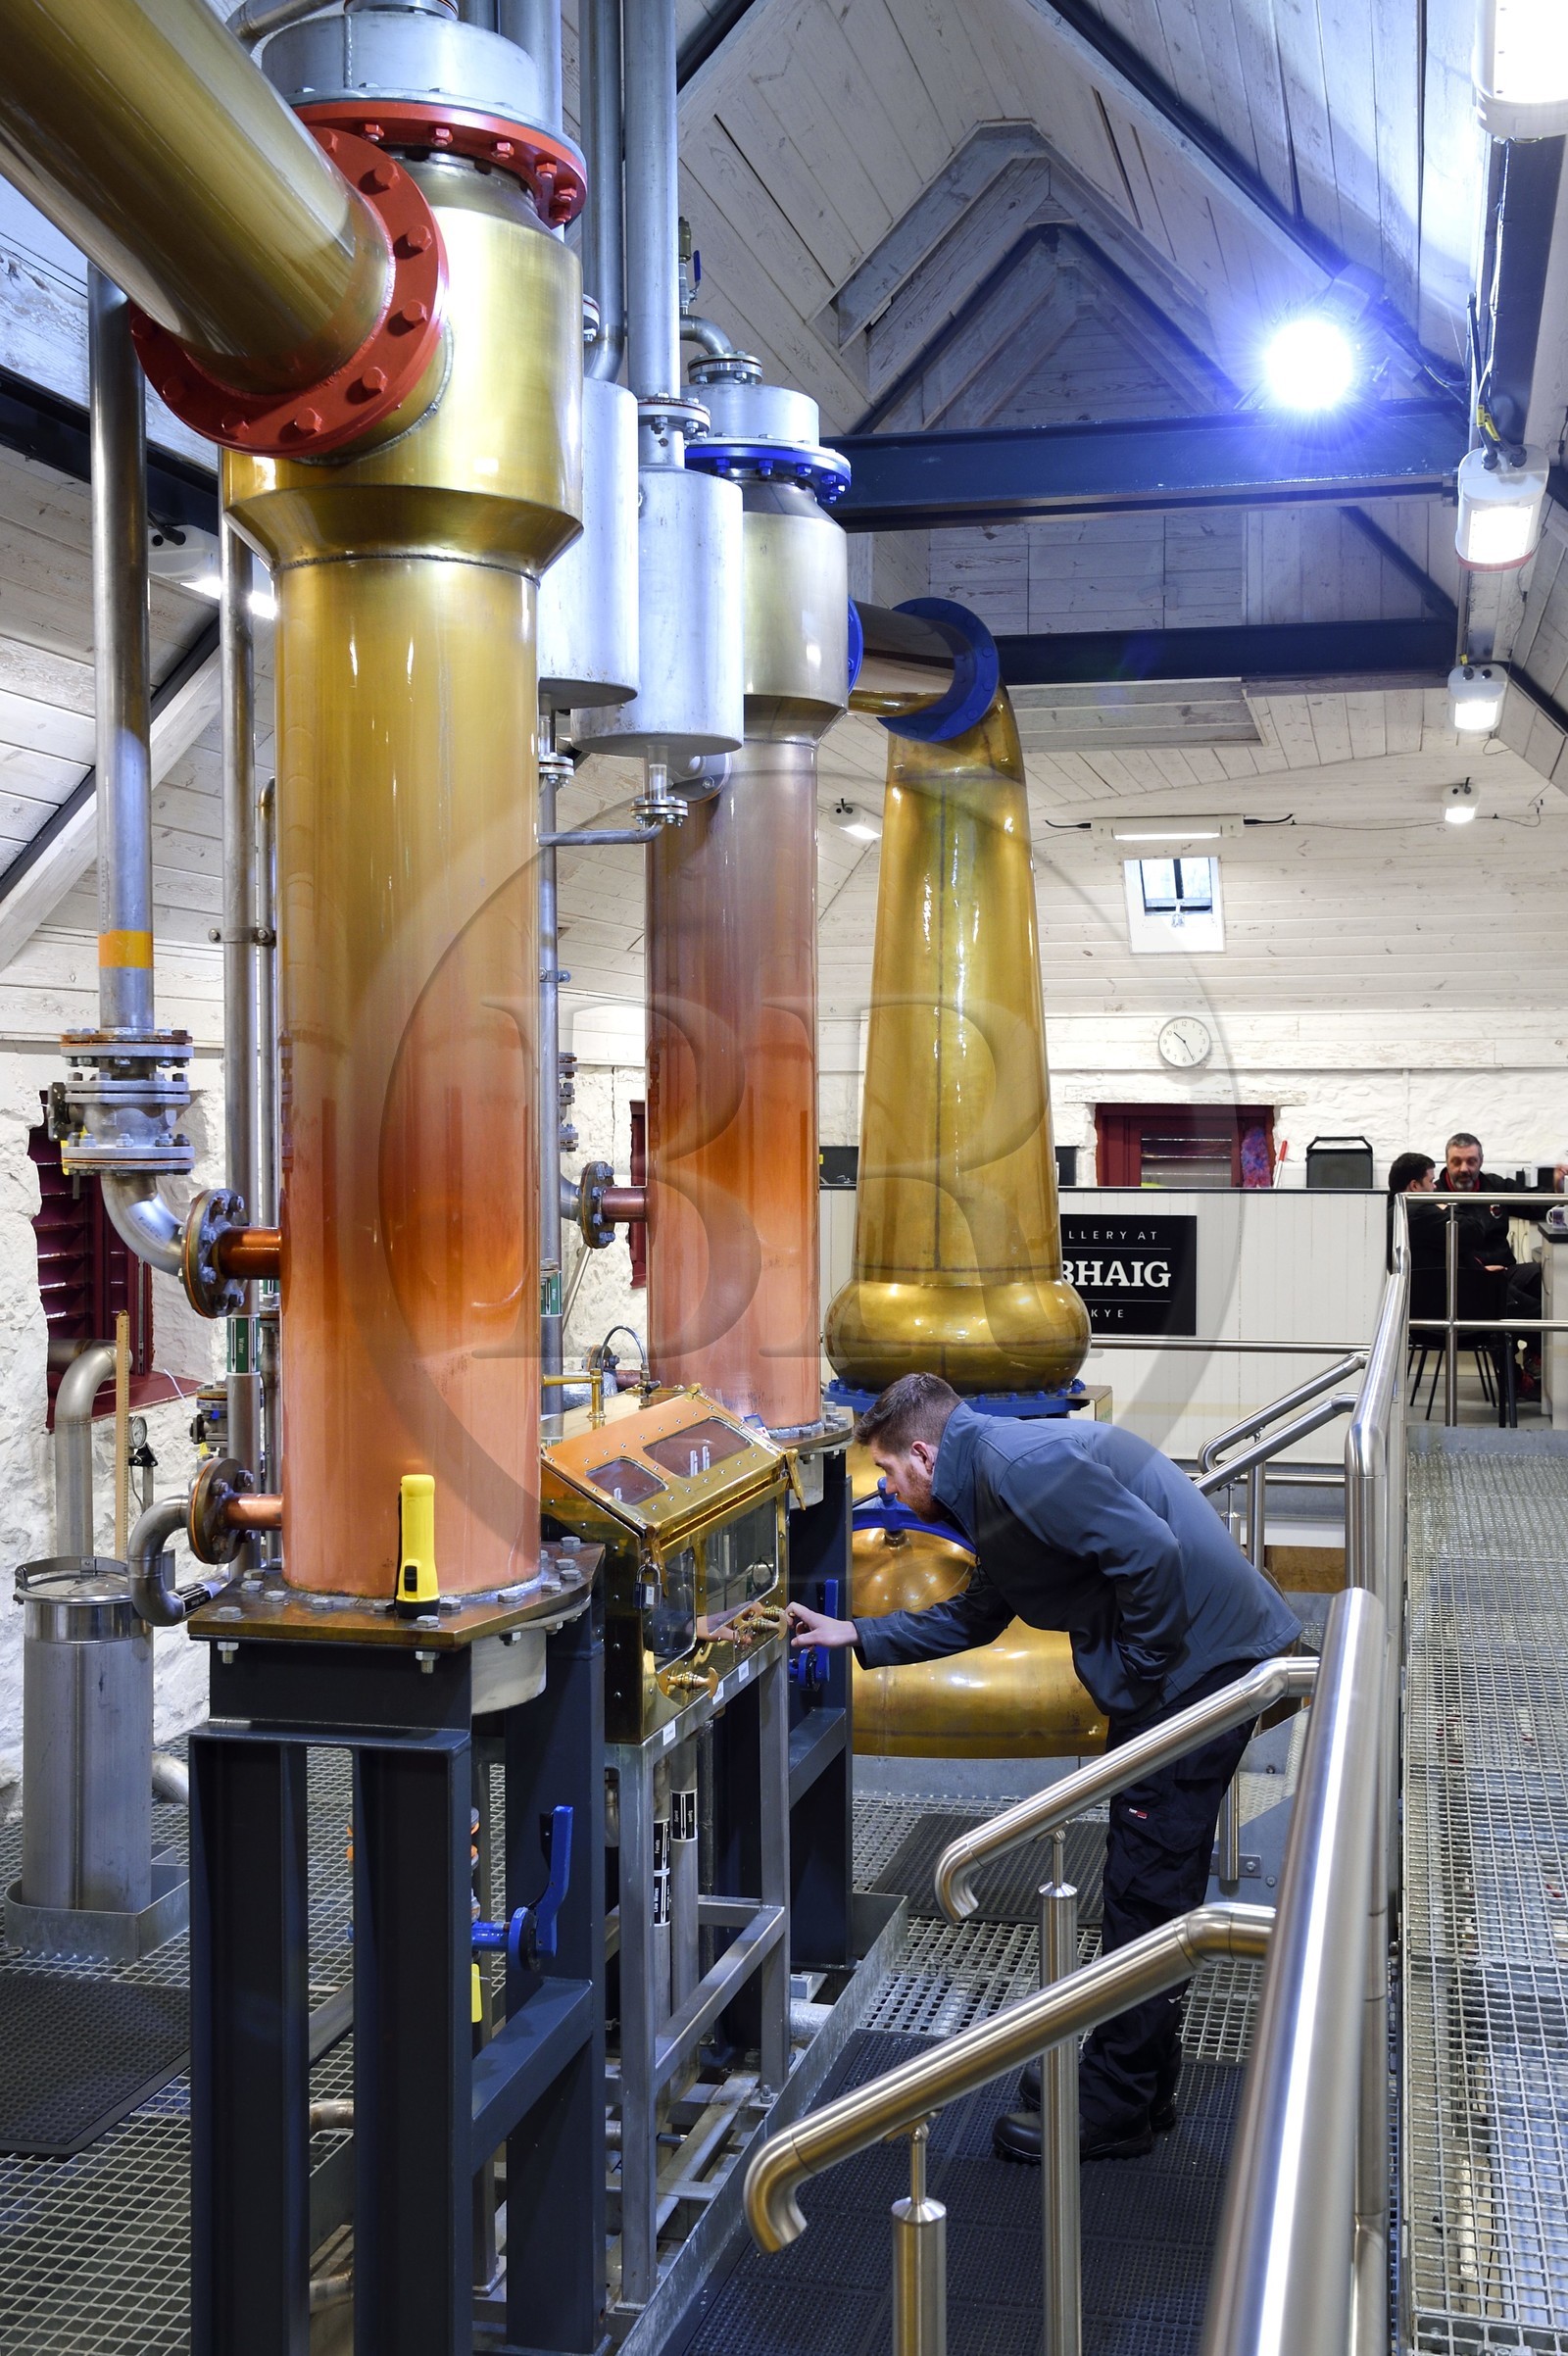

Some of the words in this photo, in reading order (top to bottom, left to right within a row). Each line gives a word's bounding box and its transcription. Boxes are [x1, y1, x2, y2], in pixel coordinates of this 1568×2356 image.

[1068, 1231, 1127, 1240] LLERY
[1137, 1231, 1158, 1240] AT
[1091, 1309, 1124, 1318] KYE
